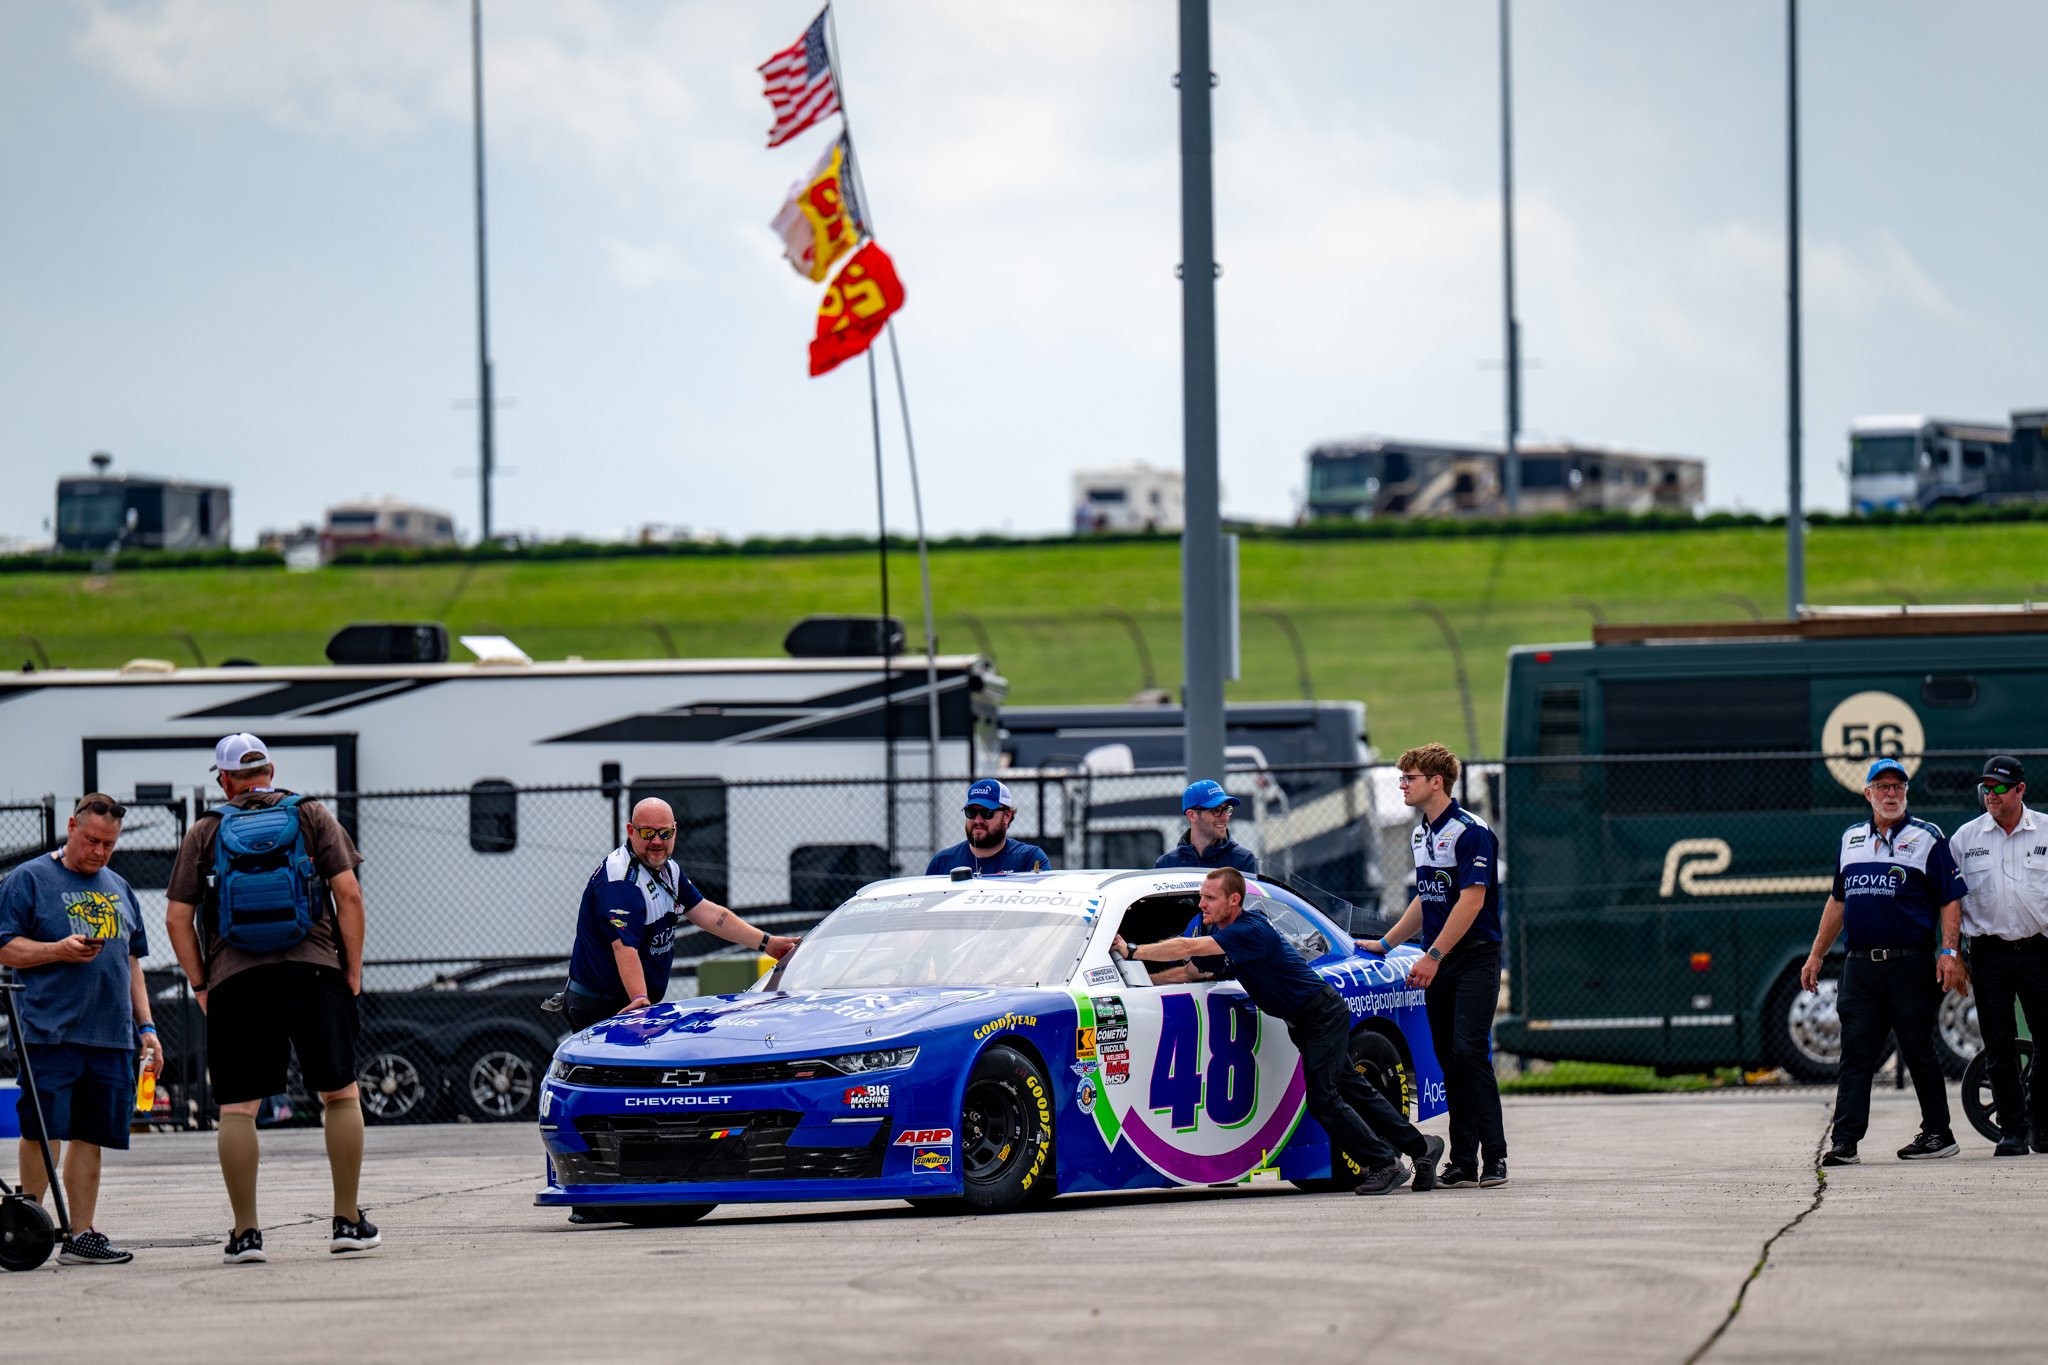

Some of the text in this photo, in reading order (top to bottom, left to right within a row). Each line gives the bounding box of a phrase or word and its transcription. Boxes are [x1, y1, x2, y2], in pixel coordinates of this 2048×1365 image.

[1841, 724, 1905, 761] 56
[1105, 973, 1115, 981] CAR
[973, 1012, 1037, 1040] GOODYEAR
[1096, 1026, 1128, 1041] COMETIC
[1101, 1043, 1125, 1054] LINCOLN
[1106, 1053, 1127, 1061] WELDERS
[1149, 990, 1260, 1133] 48
[1105, 1061, 1129, 1076] Holley
[1105, 1074, 1128, 1085] MSD
[867, 1085, 890, 1096] BIG
[1395, 1063, 1410, 1117] EAGLE
[625, 1095, 732, 1107] CHEVROLET
[850, 1096, 890, 1104] MACHINE
[895, 1129, 952, 1143] ARP
[1021, 1075, 1051, 1190] GOODYEAR
[915, 1156, 950, 1165] SUNOCO
